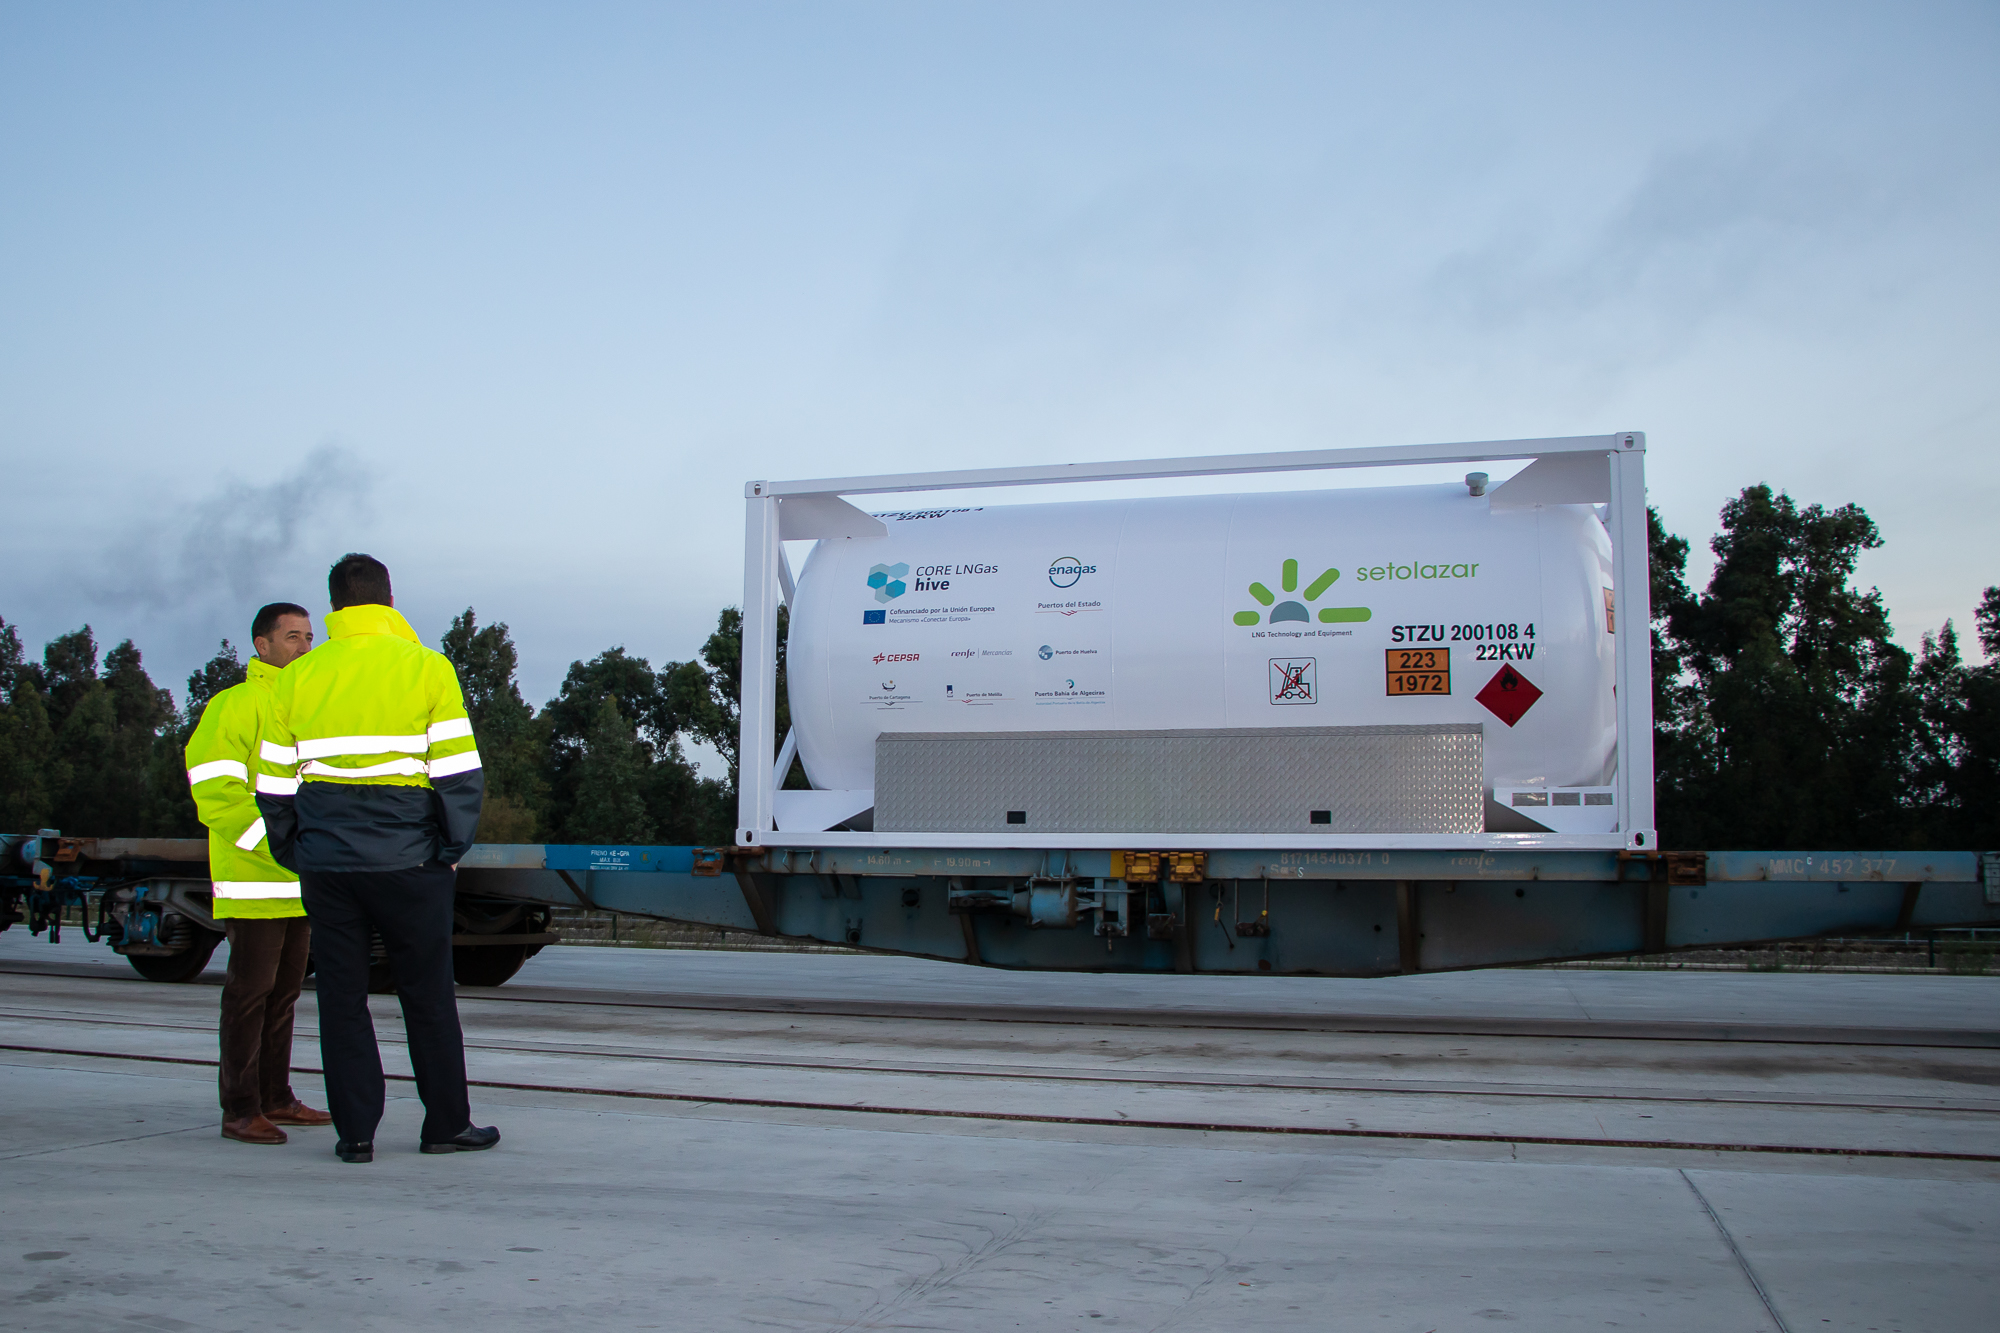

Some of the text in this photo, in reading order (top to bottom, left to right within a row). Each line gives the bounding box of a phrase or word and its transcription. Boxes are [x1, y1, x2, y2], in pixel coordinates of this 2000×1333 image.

[916, 563, 999, 576] CORE LNGas
[1048, 565, 1097, 577] enagas
[1356, 561, 1480, 582] setolazar
[914, 577, 950, 591] hive
[1391, 623, 1536, 643] STZU 200108 4
[887, 653, 920, 662] CEPSA
[950, 648, 976, 659] renfe
[1399, 651, 1436, 669] 223
[1475, 643, 1536, 661] 22KW
[1394, 674, 1443, 692] 1972
[1451, 852, 1495, 869] renfe
[1819, 859, 1854, 875] 452
[1860, 858, 1897, 875] 377
